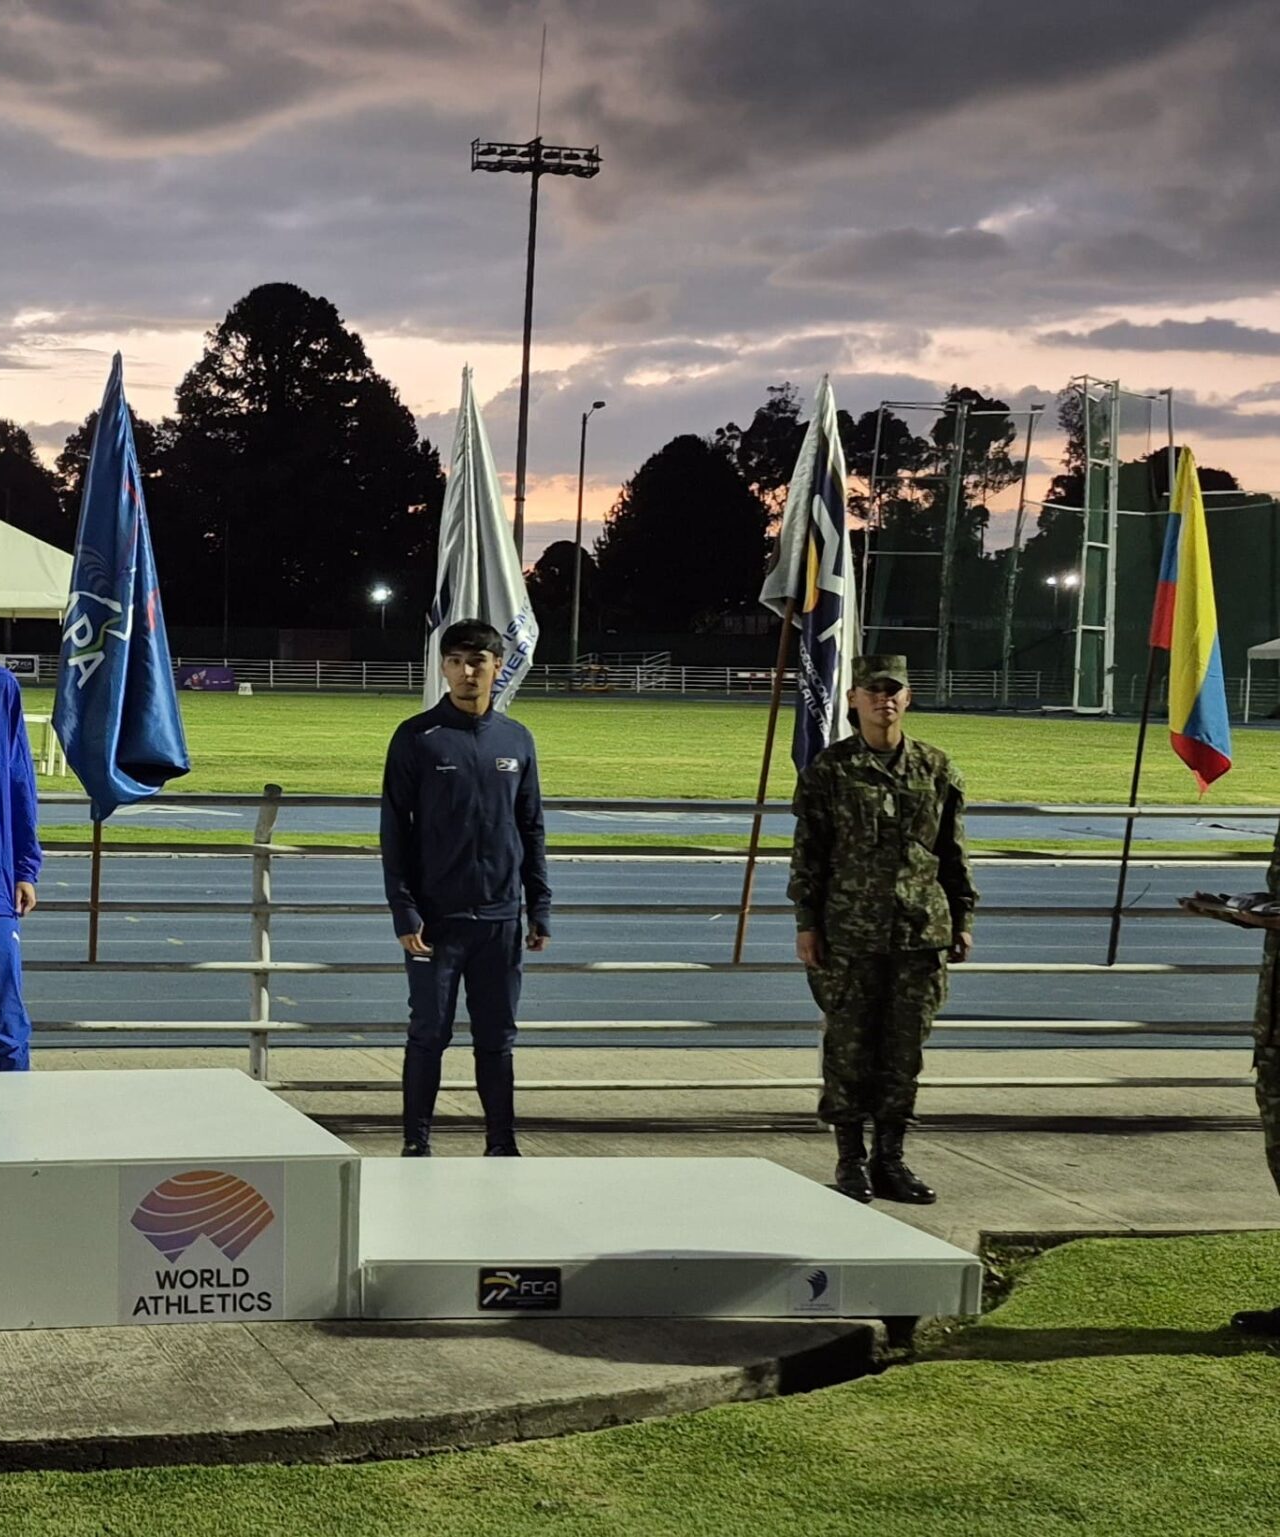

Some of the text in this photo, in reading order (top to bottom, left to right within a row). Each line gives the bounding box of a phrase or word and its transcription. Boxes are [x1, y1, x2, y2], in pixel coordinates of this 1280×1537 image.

[155, 1268, 250, 1290] WORLD
[520, 1281, 557, 1295] FCA
[132, 1292, 272, 1317] ATHLETICS
